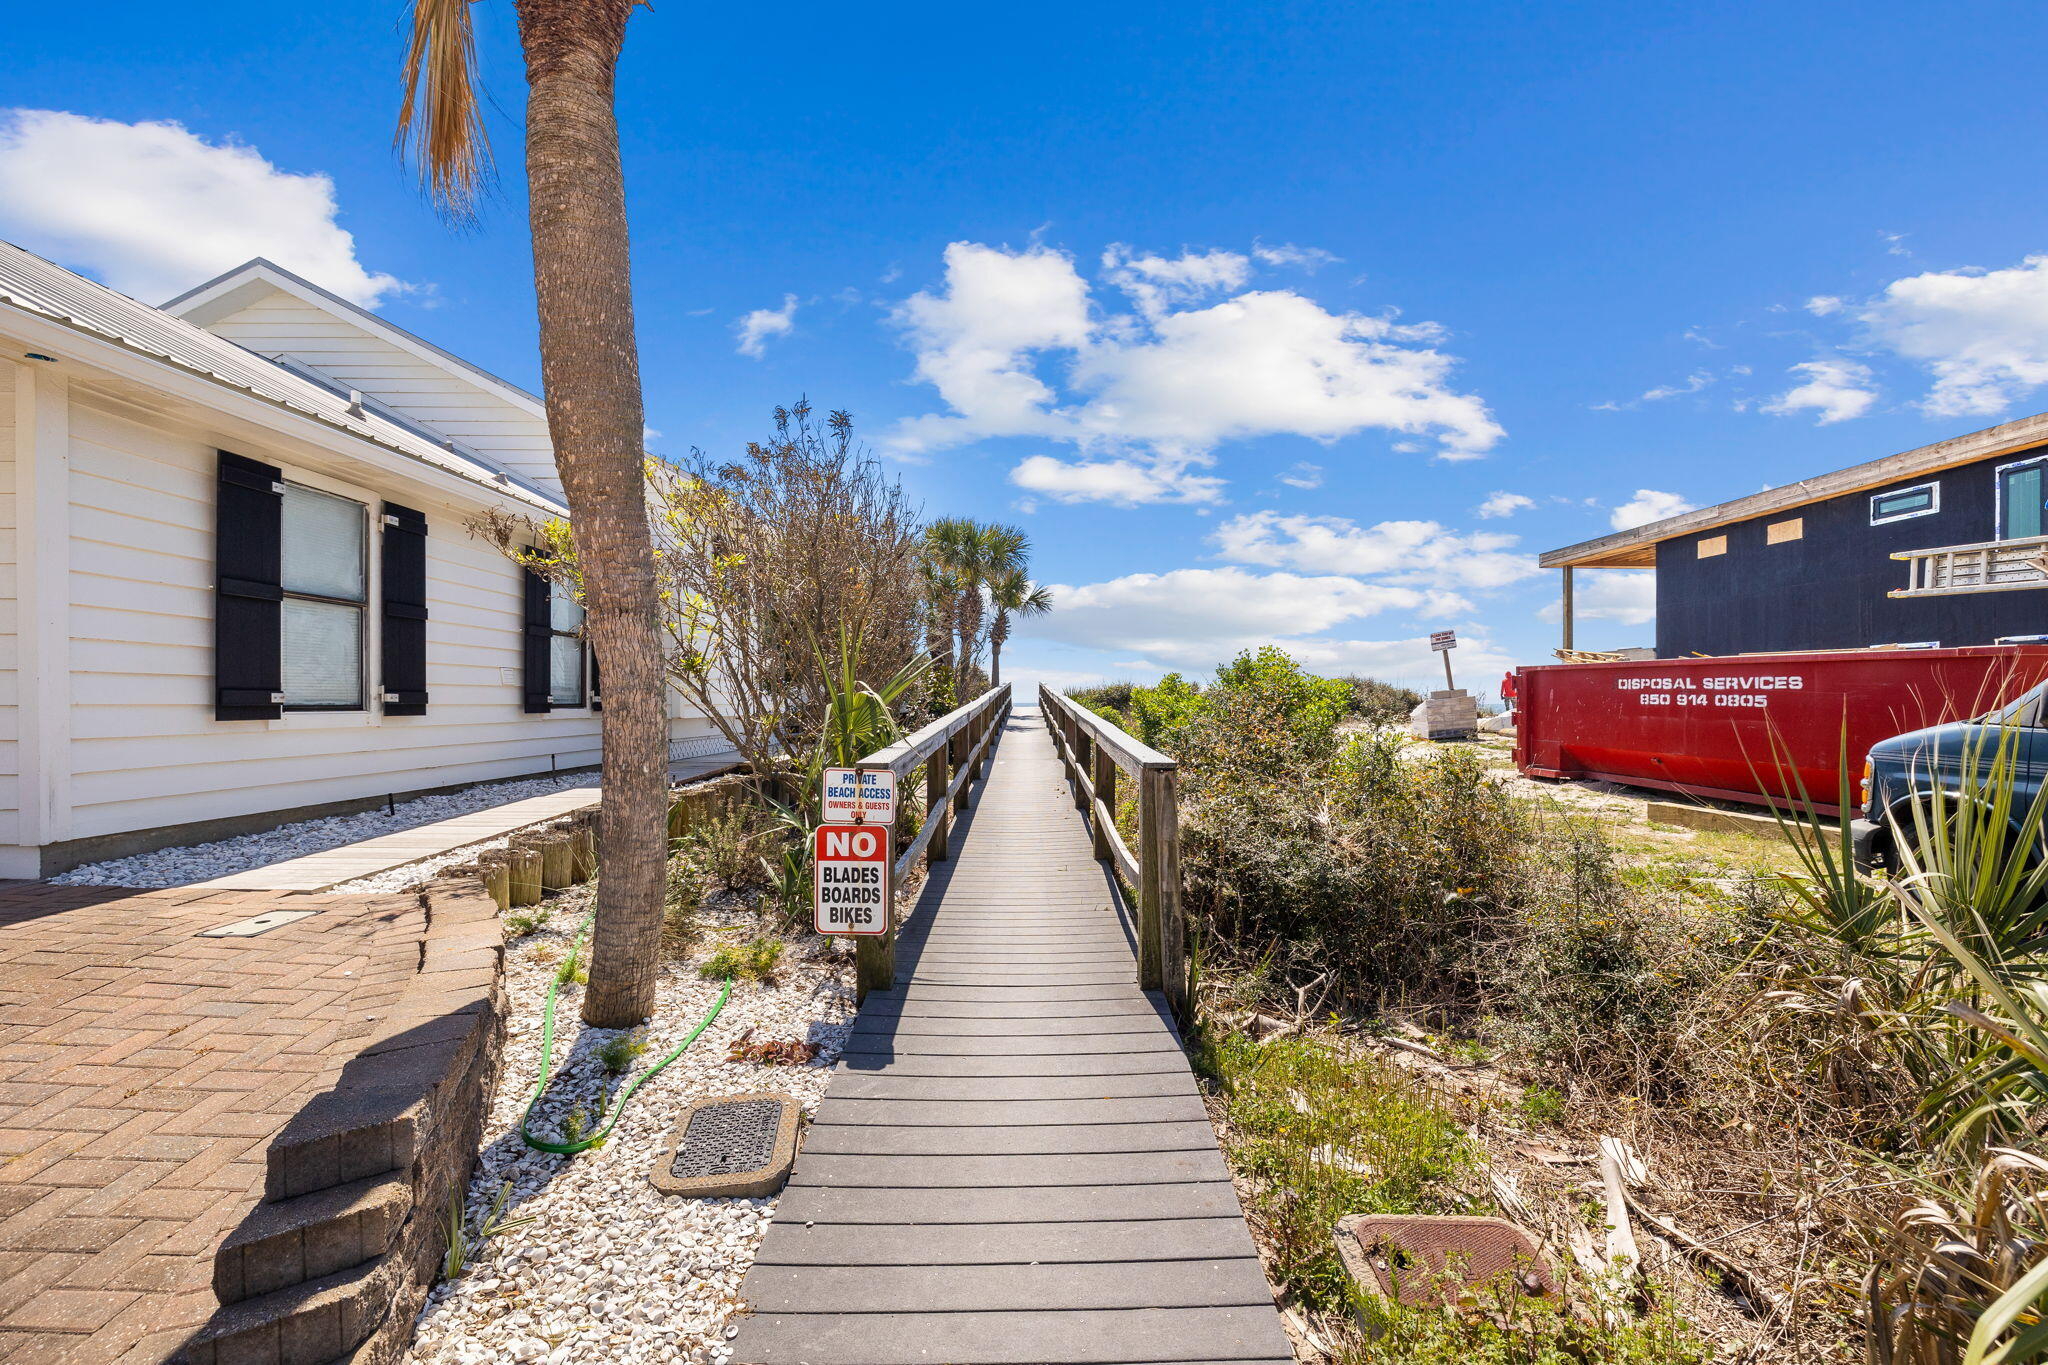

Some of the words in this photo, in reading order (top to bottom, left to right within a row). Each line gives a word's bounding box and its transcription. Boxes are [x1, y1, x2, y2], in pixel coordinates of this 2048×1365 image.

[1618, 678, 1696, 690] DISPOSAL
[1703, 676, 1804, 690] SERVICES
[1640, 693, 1671, 706] 850
[1677, 693, 1708, 706] 914
[1715, 694, 1768, 708] 0805
[828, 786, 856, 798] BEACH
[859, 787, 891, 800] ACCESS
[828, 800, 856, 809] OWNERS
[858, 802, 864, 810] &
[866, 801, 890, 811] GUESTS
[826, 831, 877, 858] NO
[823, 866, 879, 884] BLADES
[822, 886, 881, 904] BOARDS
[829, 906, 873, 924] BIKES
